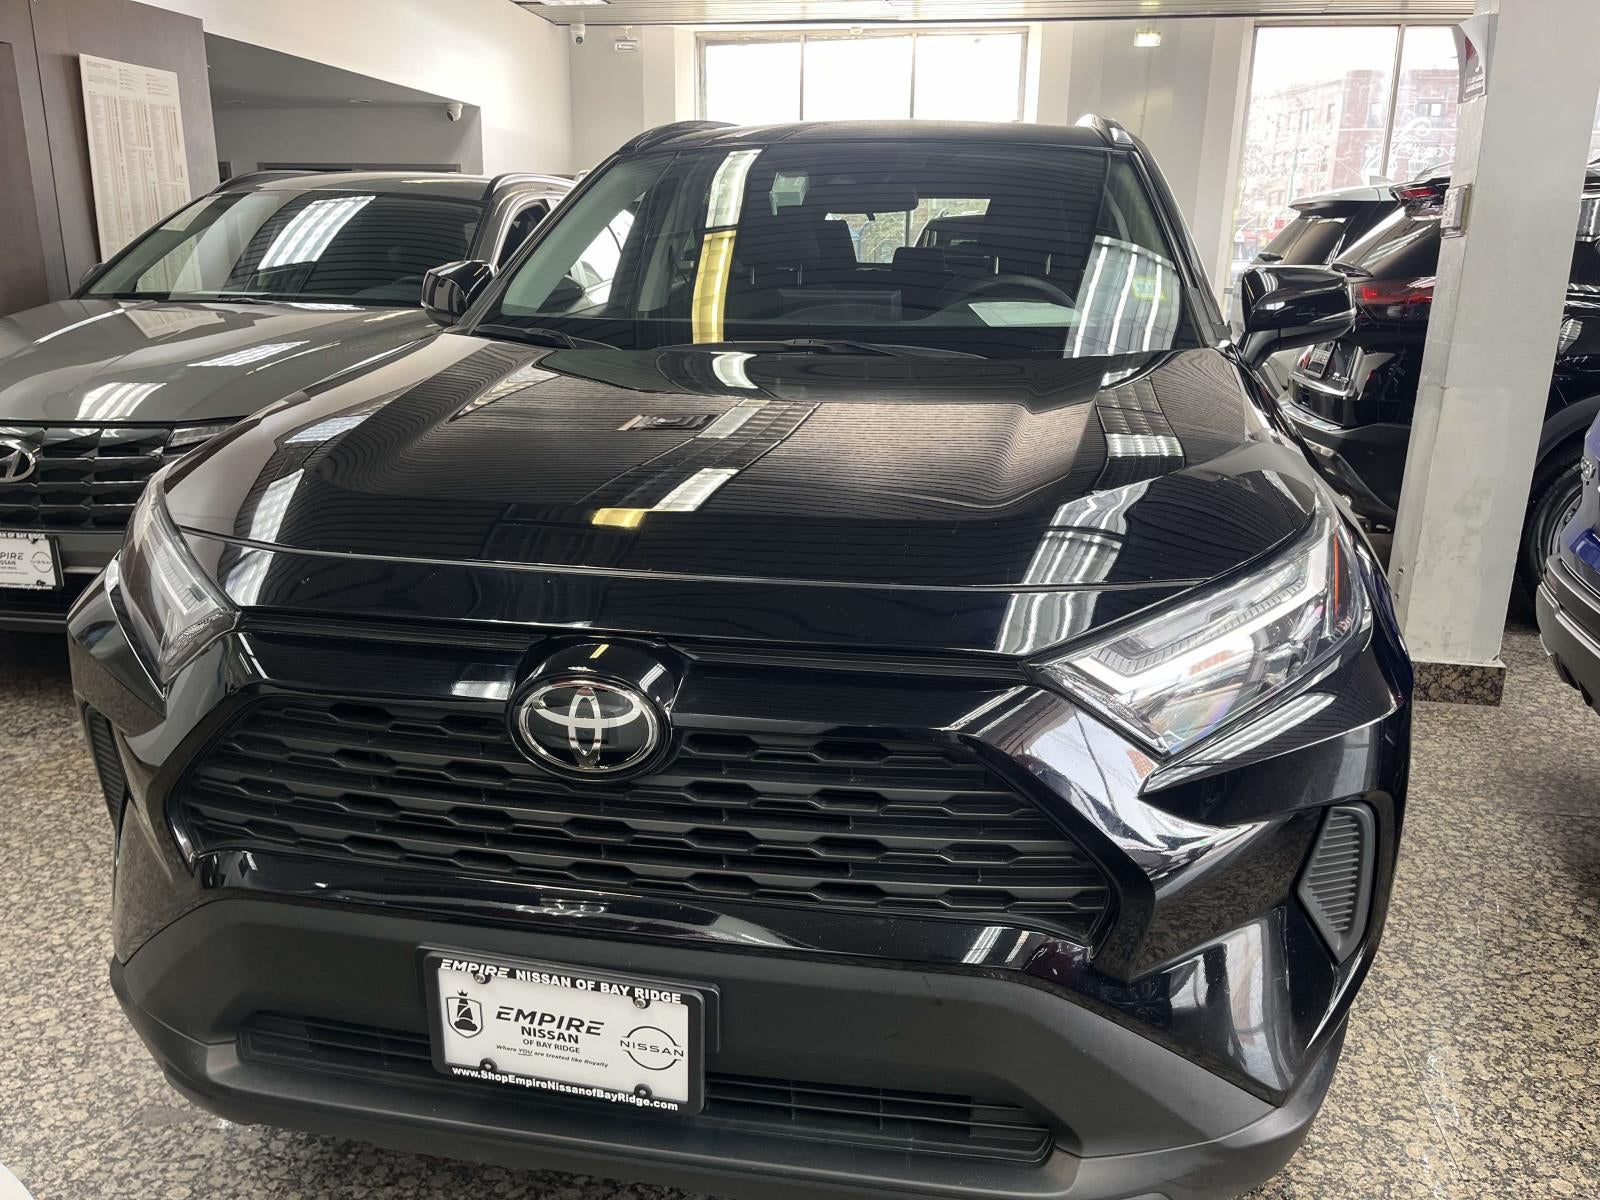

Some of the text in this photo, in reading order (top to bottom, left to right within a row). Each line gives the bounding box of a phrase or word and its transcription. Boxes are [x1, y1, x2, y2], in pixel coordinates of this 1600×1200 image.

[0, 551, 24, 560] PIRE
[440, 959, 681, 1004] EMPIRE NISSAN OF BAY RIDGE
[496, 1005, 605, 1036] EMPIRE
[520, 1026, 579, 1044] NISSAN
[522, 1038, 580, 1054] OF BAY RIDGE
[619, 1039, 684, 1057] NISSAN
[546, 1052, 570, 1061] treated
[583, 1059, 608, 1069] Royalty
[452, 1066, 679, 1112] www.ShopEmpireNissanofBayRidge.com
